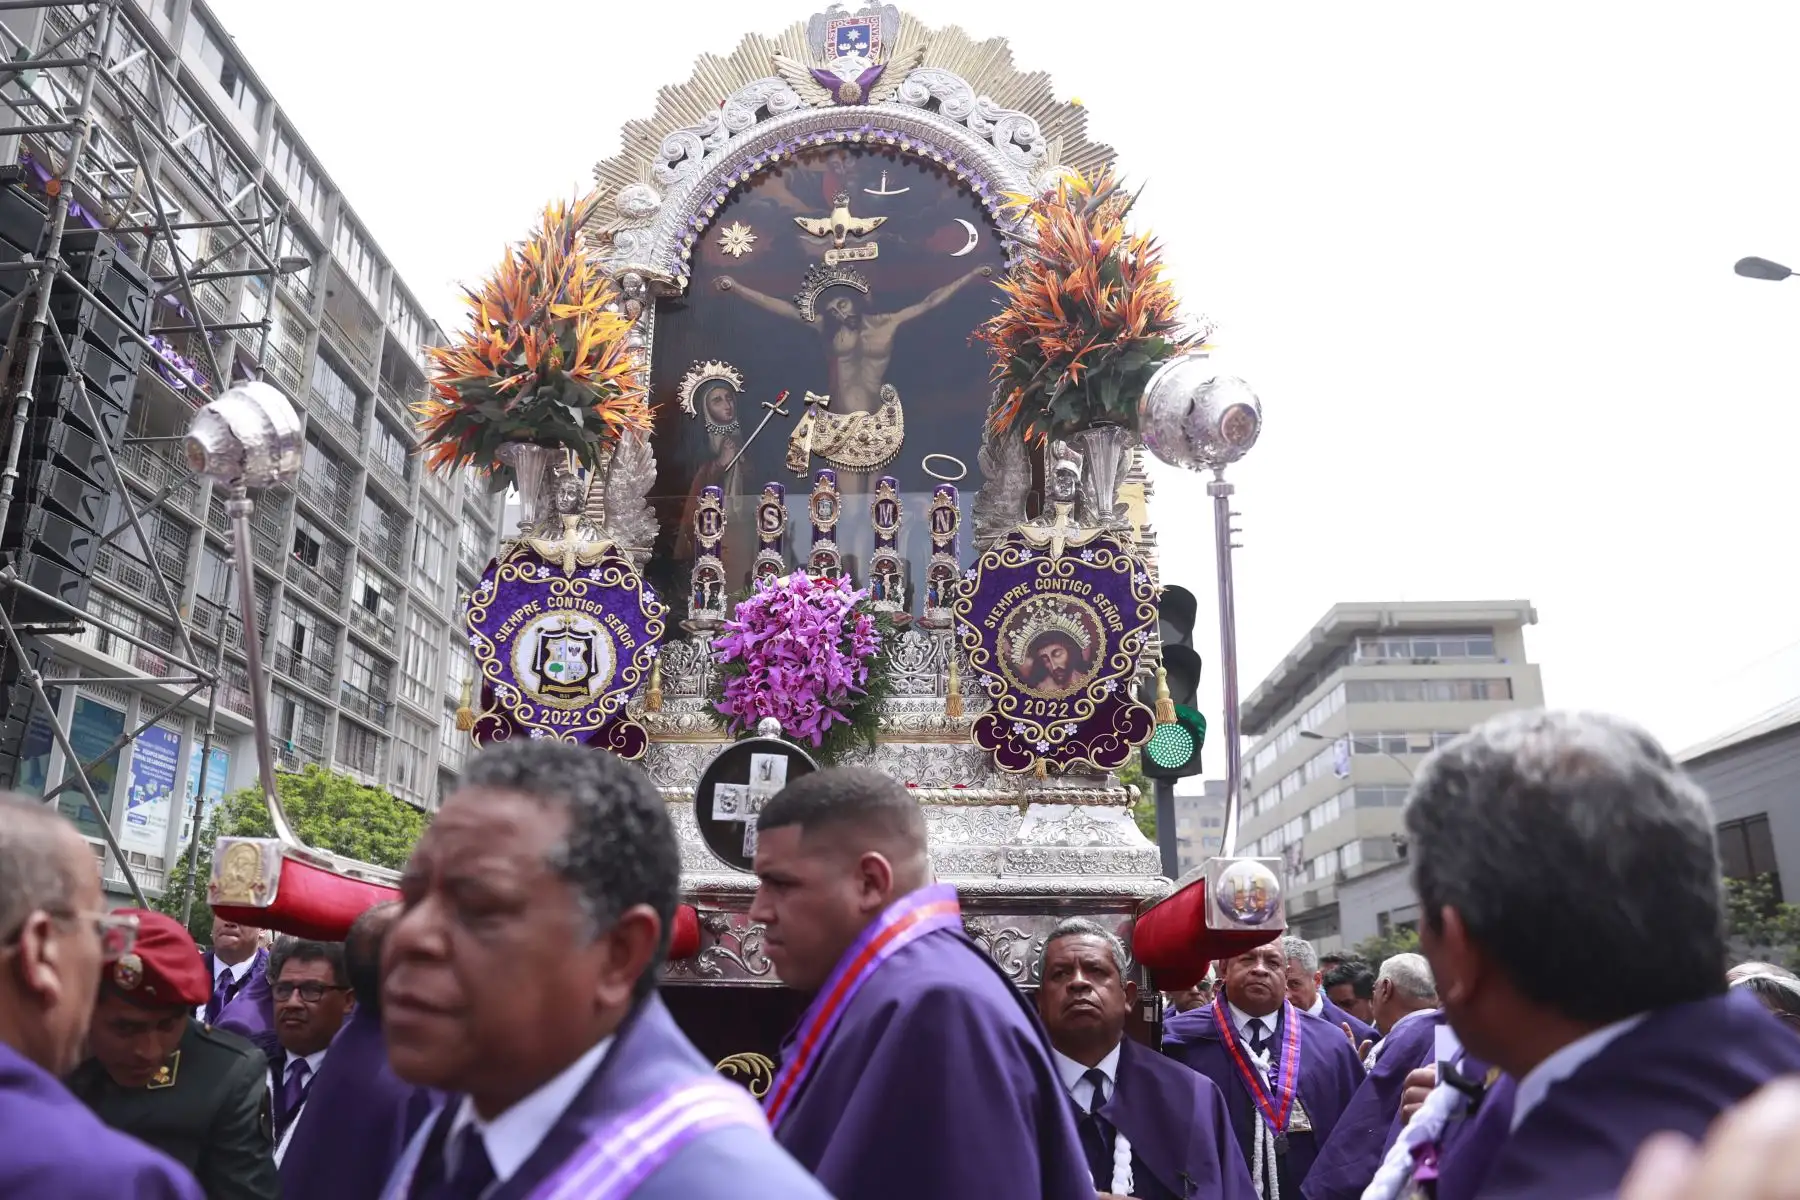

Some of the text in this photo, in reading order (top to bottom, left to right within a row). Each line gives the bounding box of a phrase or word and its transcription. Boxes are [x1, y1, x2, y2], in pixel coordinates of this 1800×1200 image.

[702, 503, 951, 535] H S M N
[985, 579, 1123, 632] SIEMPRE CONTIGO SEÑOR
[496, 597, 635, 649] SIEMPRE CONTIGO SEÑOR
[540, 710, 581, 726] 2022
[1023, 701, 1069, 717] 2022
